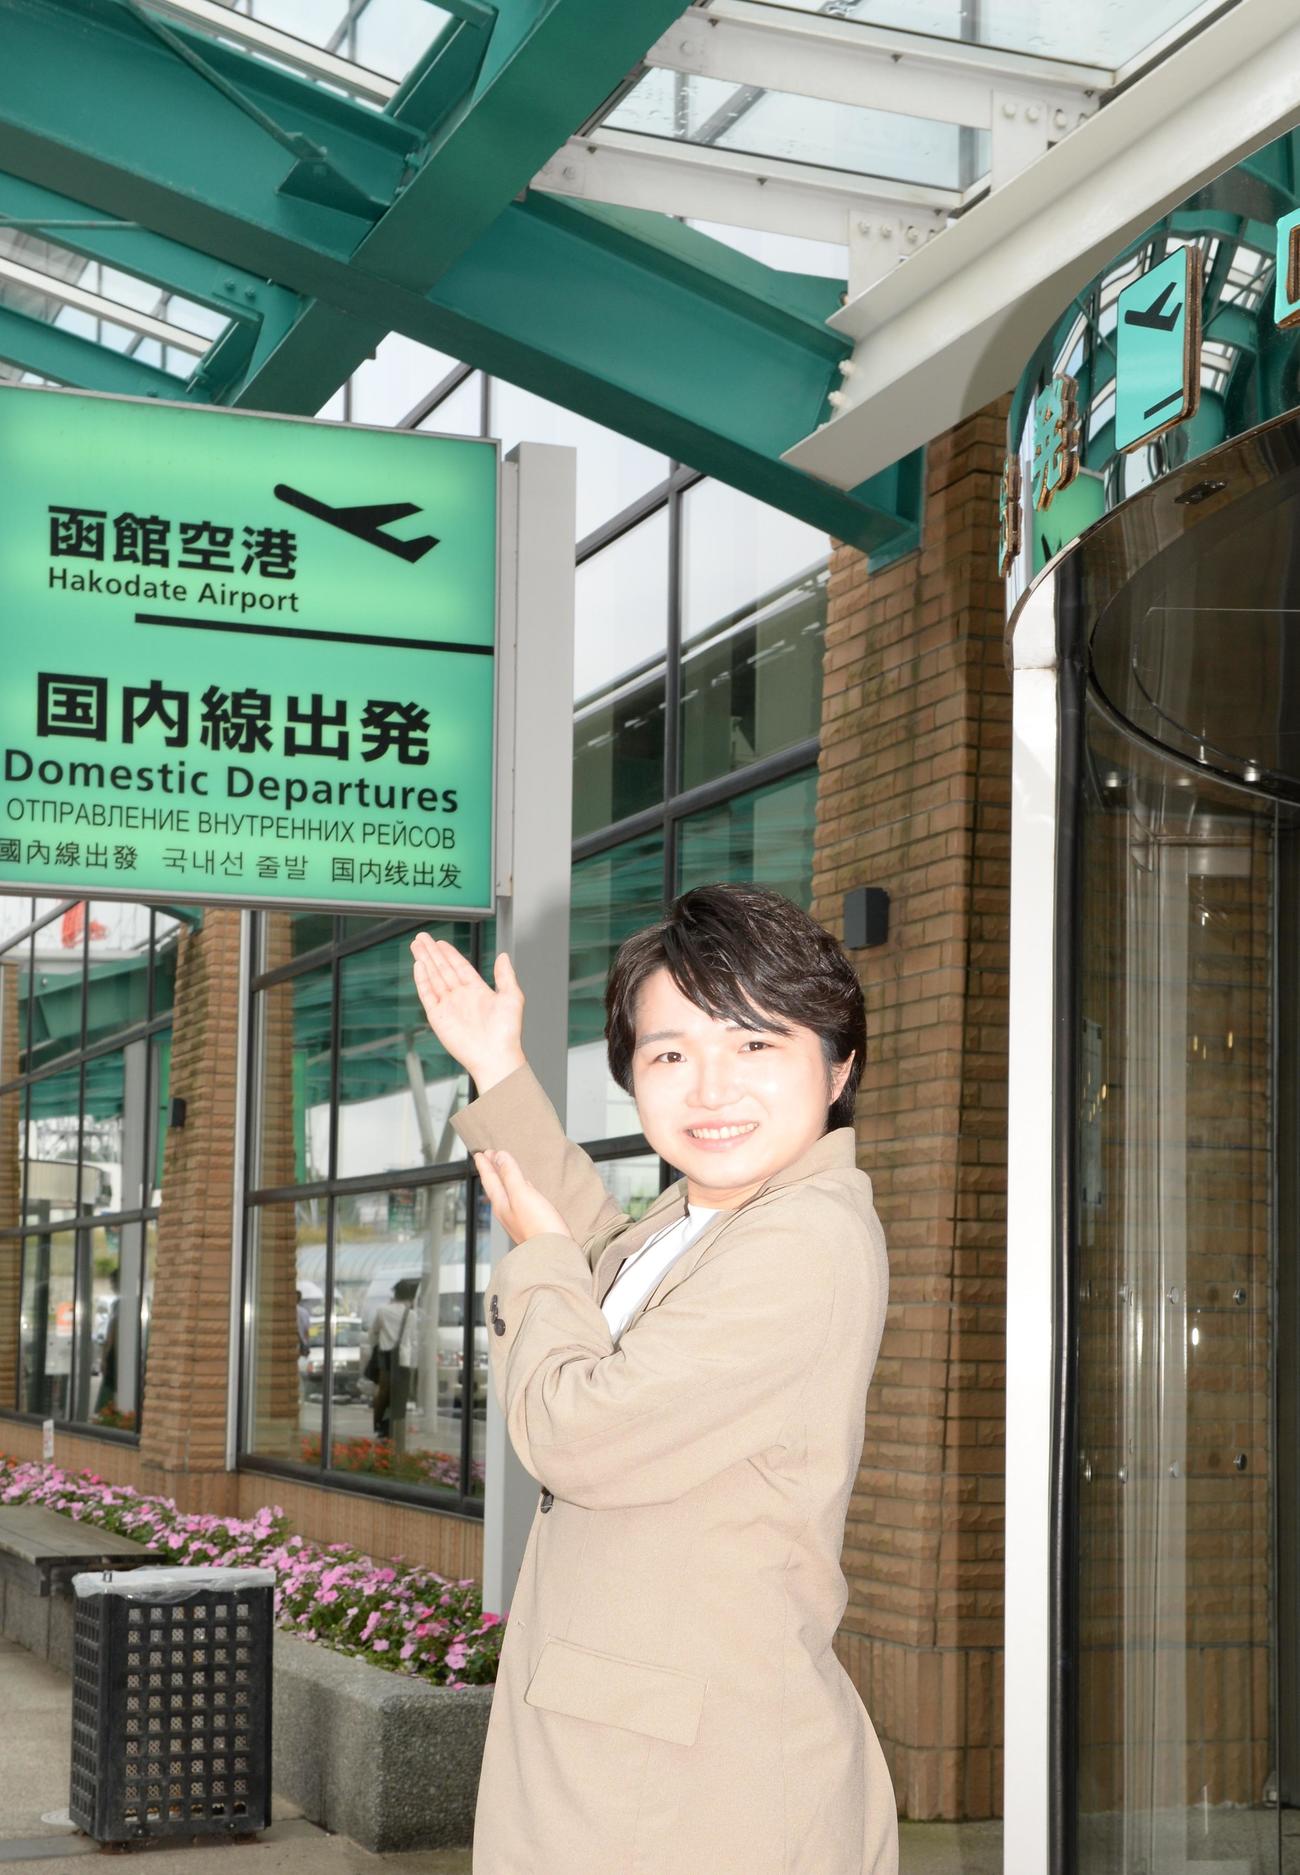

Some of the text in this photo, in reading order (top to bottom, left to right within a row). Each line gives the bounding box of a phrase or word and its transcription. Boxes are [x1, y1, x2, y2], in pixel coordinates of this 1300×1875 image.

[49, 506, 298, 580] 函館空港
[48, 567, 300, 613] Hakodate Airport
[37, 671, 430, 766] 国内線出発
[4, 748, 459, 814] Domestic Departures
[6, 797, 456, 850] ОТПРАВЛЕНИЕ ВНУТРЕННИХ РЕЙСОВ
[162, 847, 244, 878] 국내선
[331, 856, 462, 889] 国内线出发
